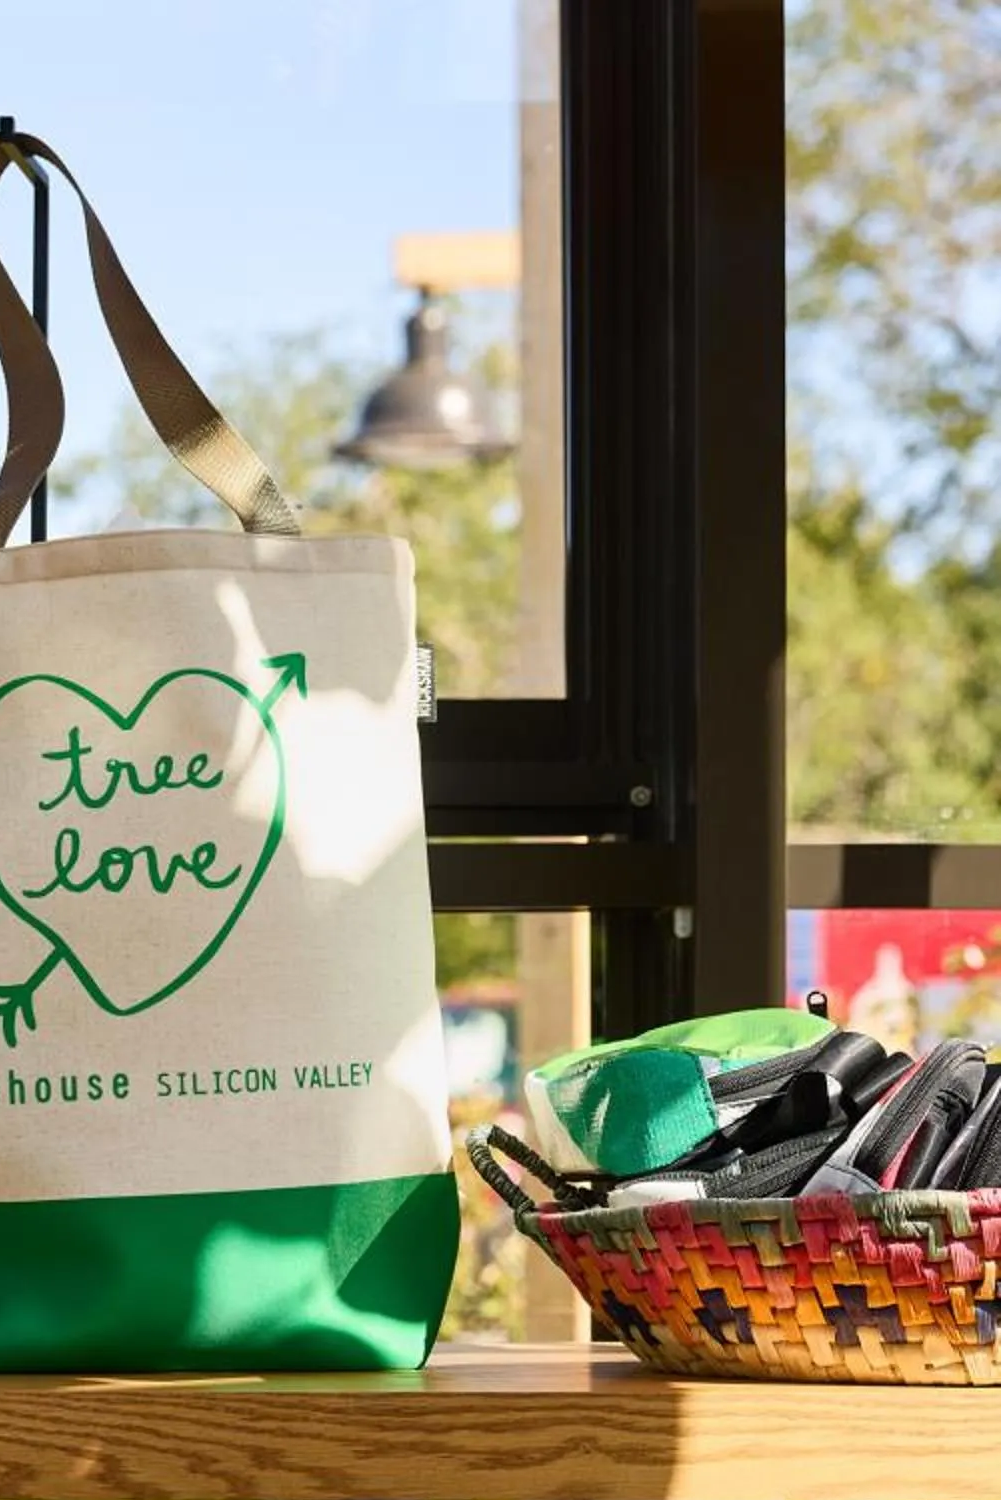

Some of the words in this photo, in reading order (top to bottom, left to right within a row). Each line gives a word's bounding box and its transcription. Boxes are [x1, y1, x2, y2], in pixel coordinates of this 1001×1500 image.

[38, 725, 225, 812] tree
[22, 827, 242, 899] love
[156, 1068, 278, 1098] SILICON
[294, 1062, 374, 1090] VALLEY
